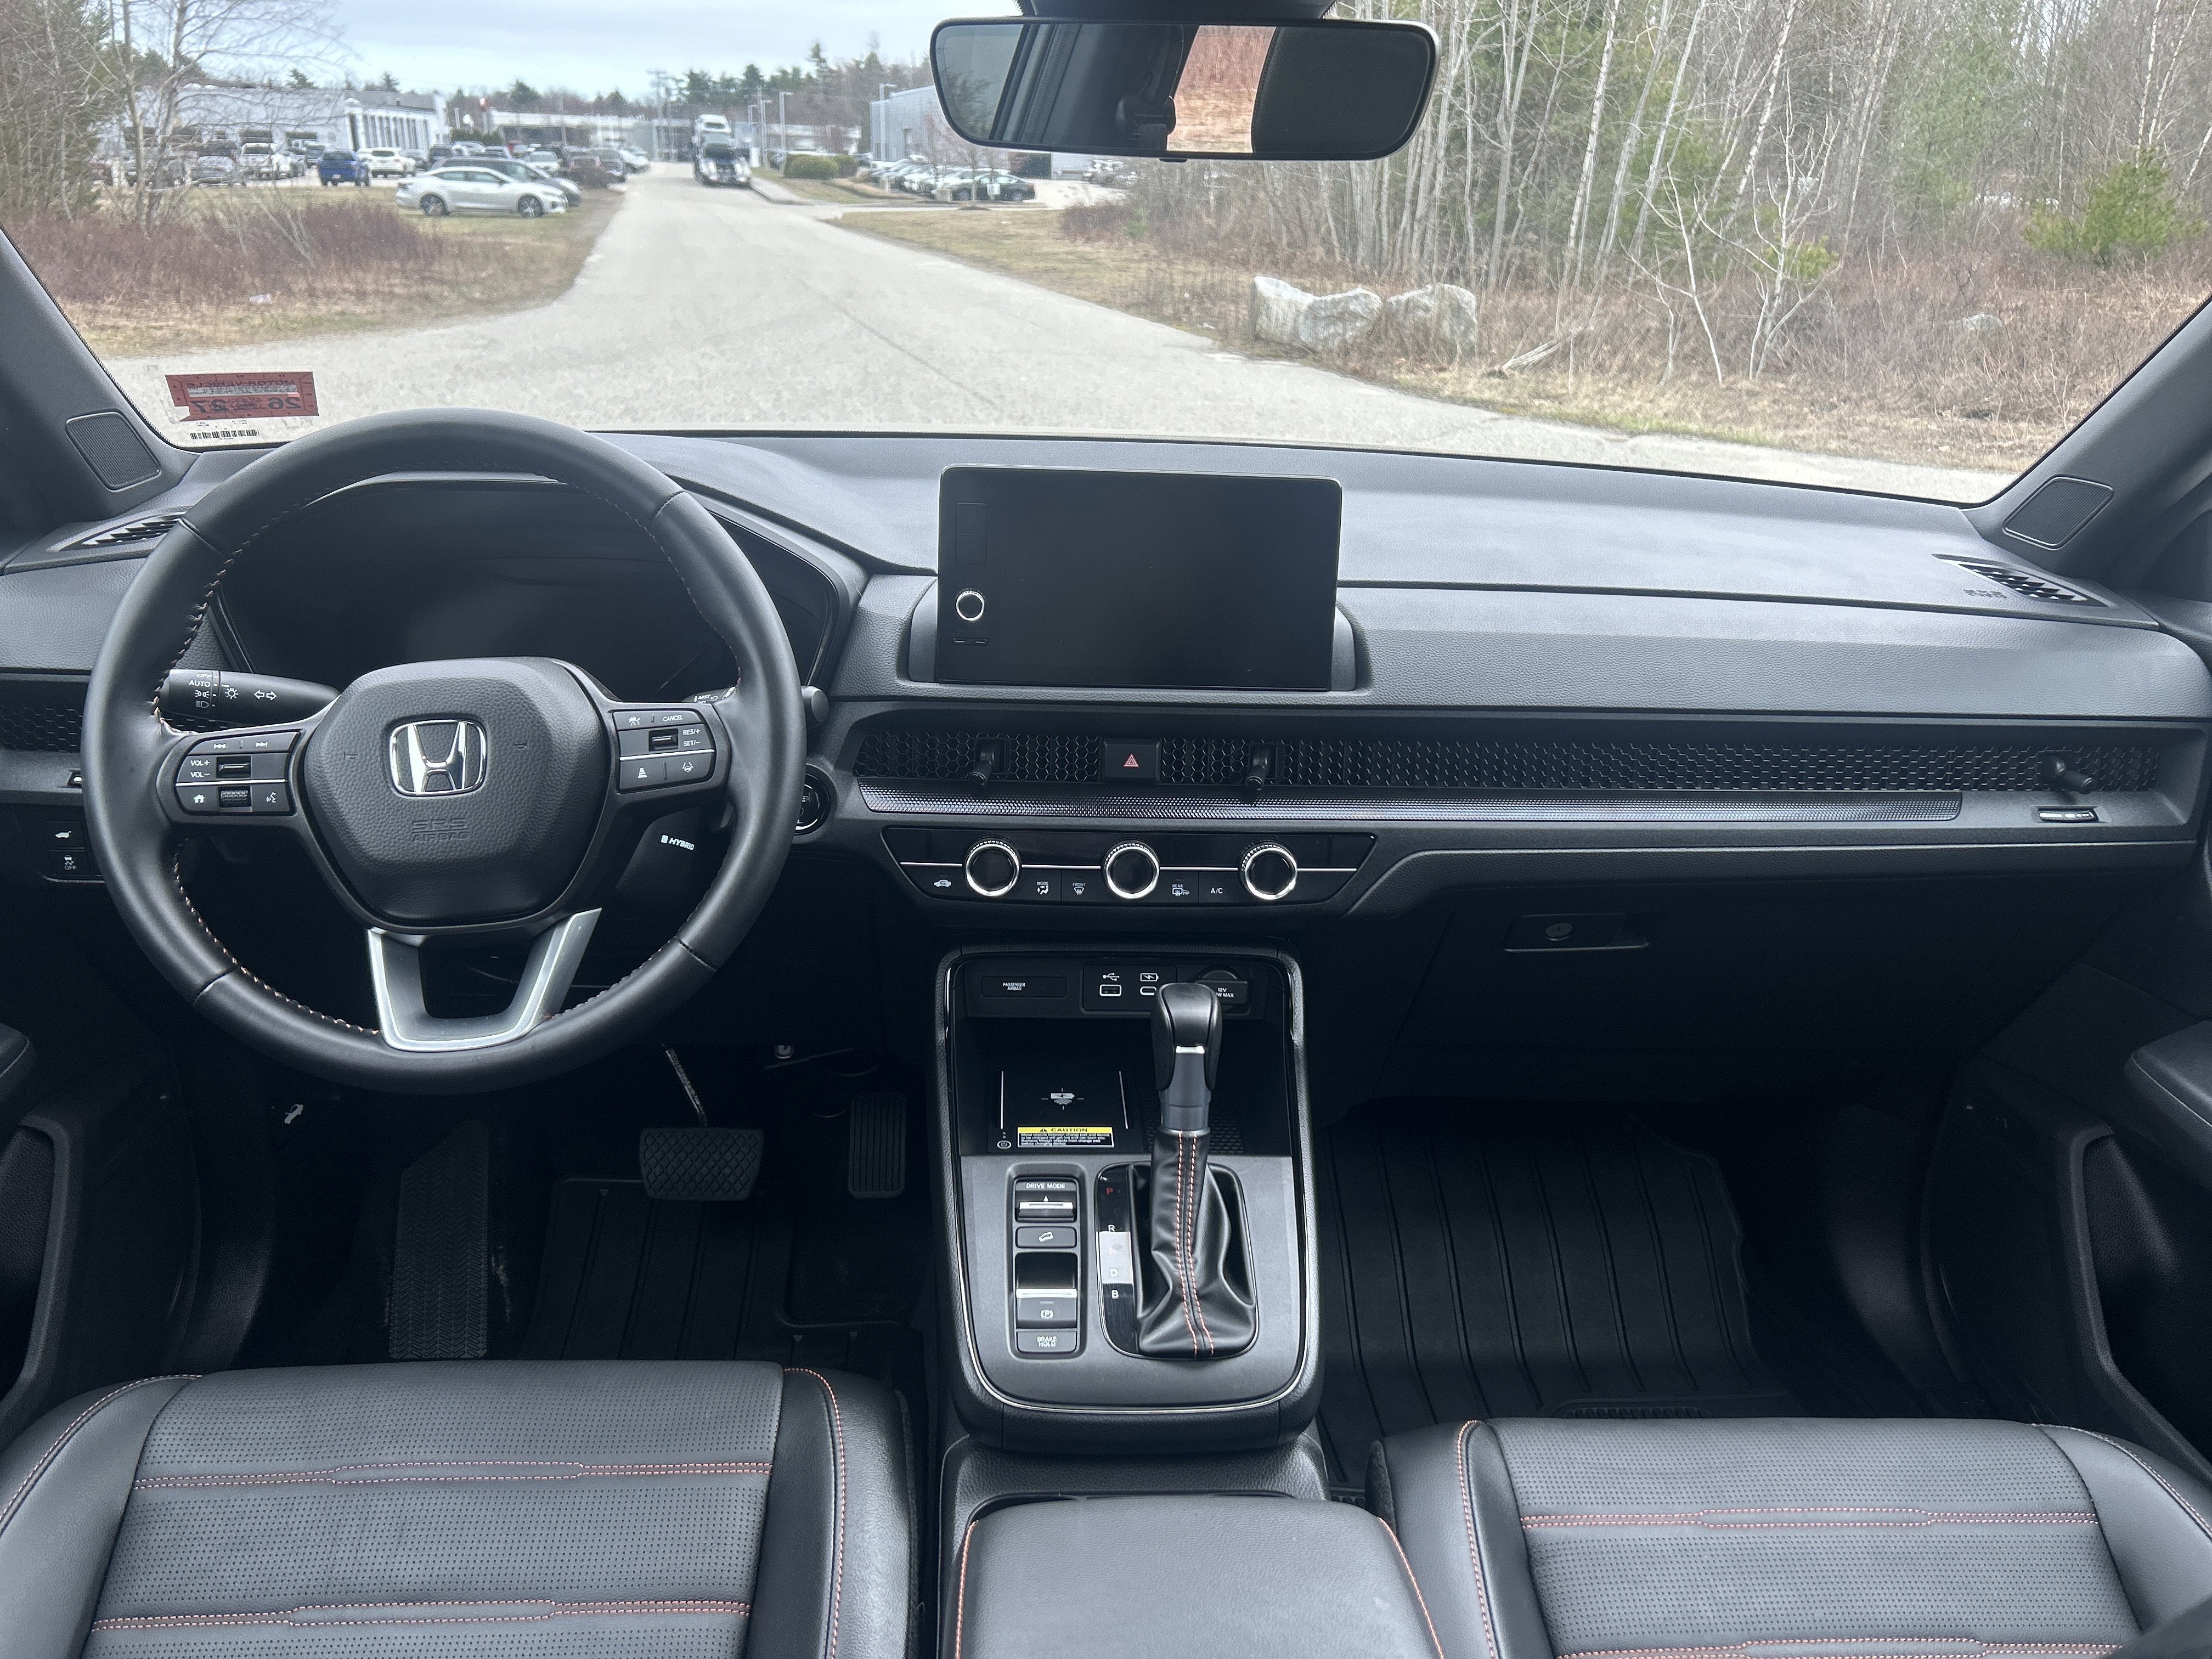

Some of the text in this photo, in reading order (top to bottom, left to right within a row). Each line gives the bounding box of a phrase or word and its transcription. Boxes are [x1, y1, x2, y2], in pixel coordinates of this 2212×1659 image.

[411, 817, 467, 831] SRS
[668, 837, 695, 850] HYBRID
[1110, 1268, 1118, 1277] D
[1111, 1290, 1119, 1299] B
